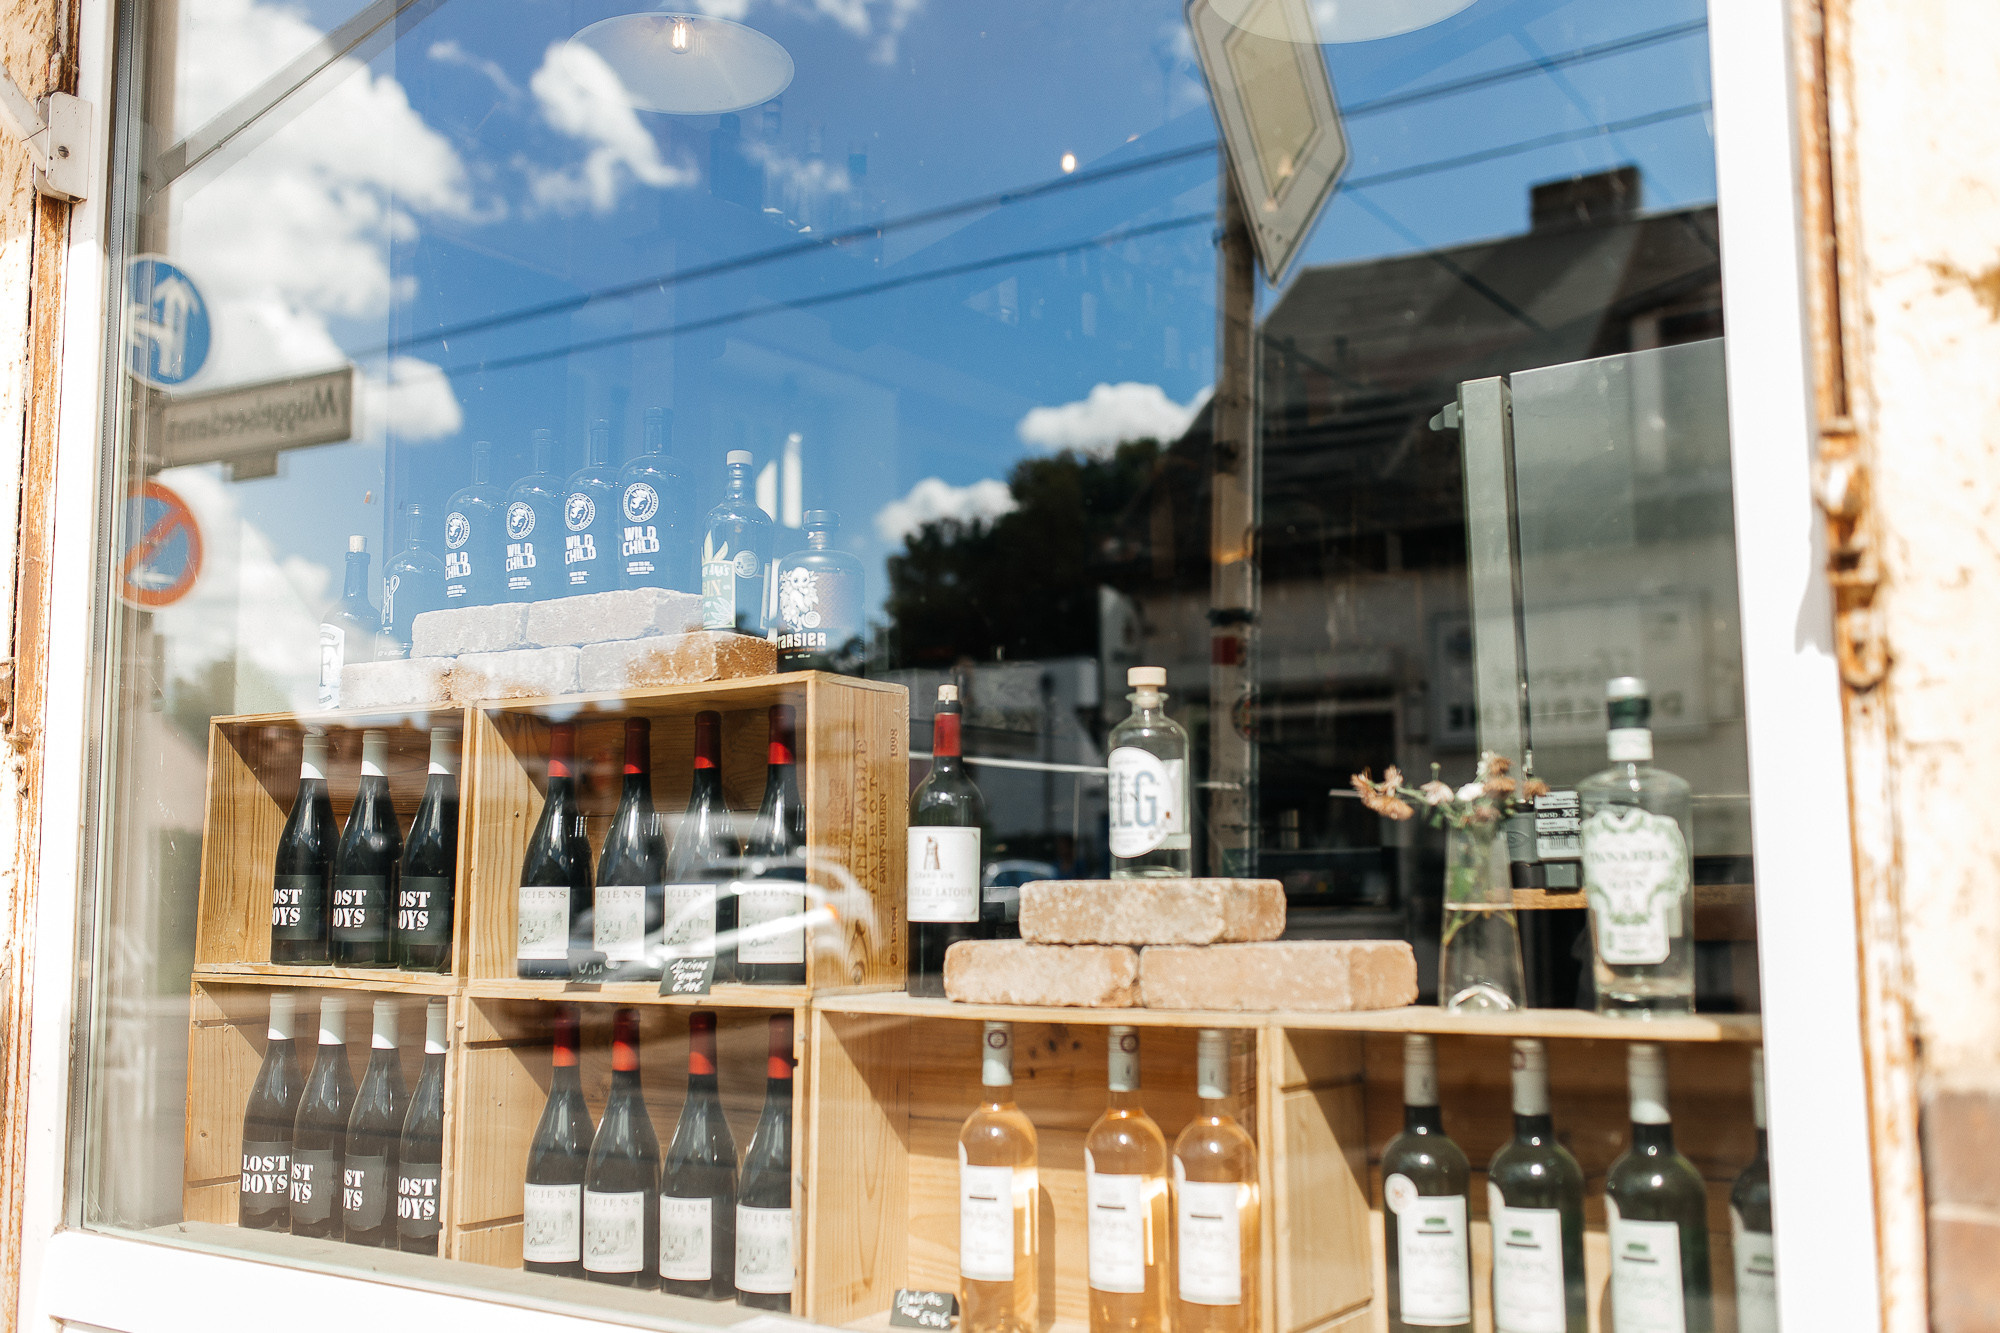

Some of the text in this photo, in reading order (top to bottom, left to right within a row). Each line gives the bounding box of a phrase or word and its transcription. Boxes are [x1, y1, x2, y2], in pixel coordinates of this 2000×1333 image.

[565, 534, 594, 550] WILD
[623, 526, 657, 541] WILD
[507, 543, 534, 557] WILD
[564, 546, 597, 565] CHILD
[622, 538, 660, 556] CHILD
[445, 552, 469, 566] WILD
[505, 555, 537, 571] CHILD
[444, 563, 472, 580] CHILD
[273, 889, 302, 905] OST
[334, 889, 367, 906] OST
[400, 890, 431, 908] OST
[272, 907, 301, 927] OYS
[332, 908, 366, 928] OYS
[398, 910, 429, 931] OYS
[242, 1154, 290, 1173] LOST
[241, 1173, 288, 1194] BOYS
